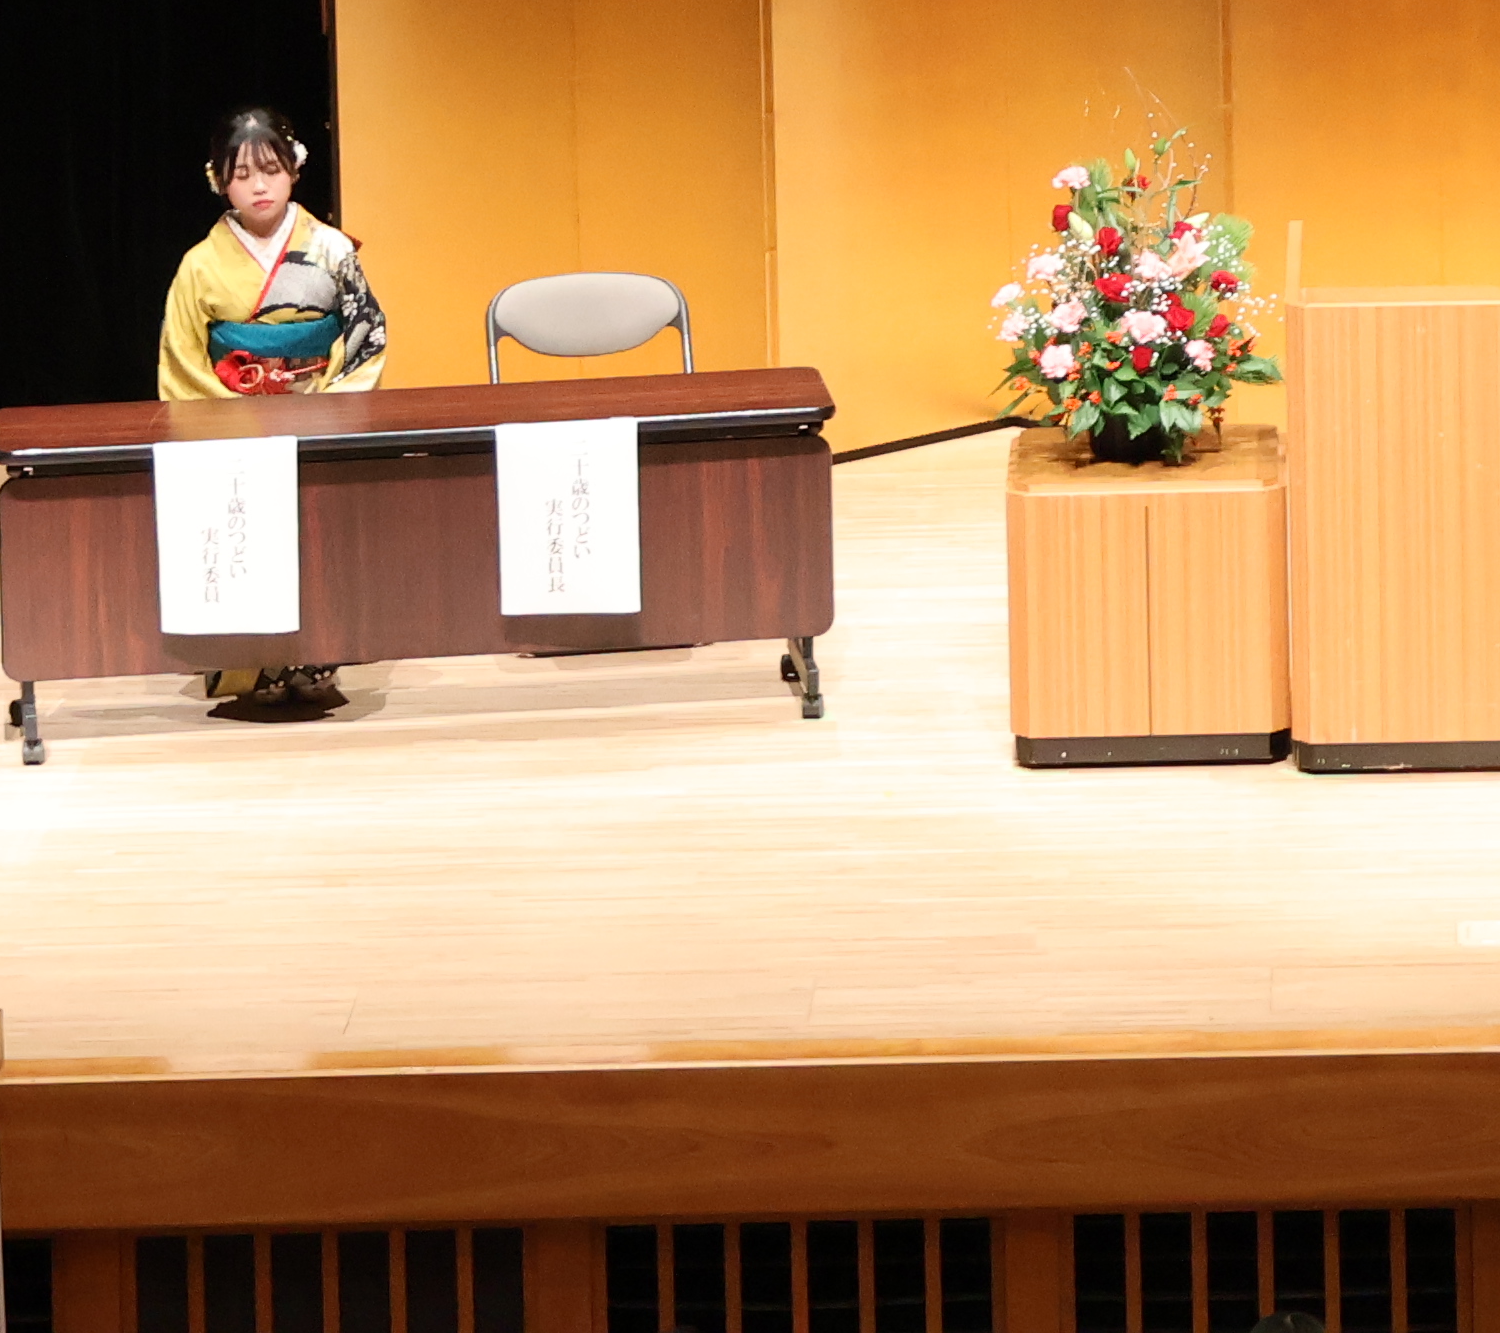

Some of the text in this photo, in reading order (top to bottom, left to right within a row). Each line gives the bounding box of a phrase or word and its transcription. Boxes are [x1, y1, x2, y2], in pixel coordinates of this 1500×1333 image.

[545, 498, 566, 594] 実行委員長
